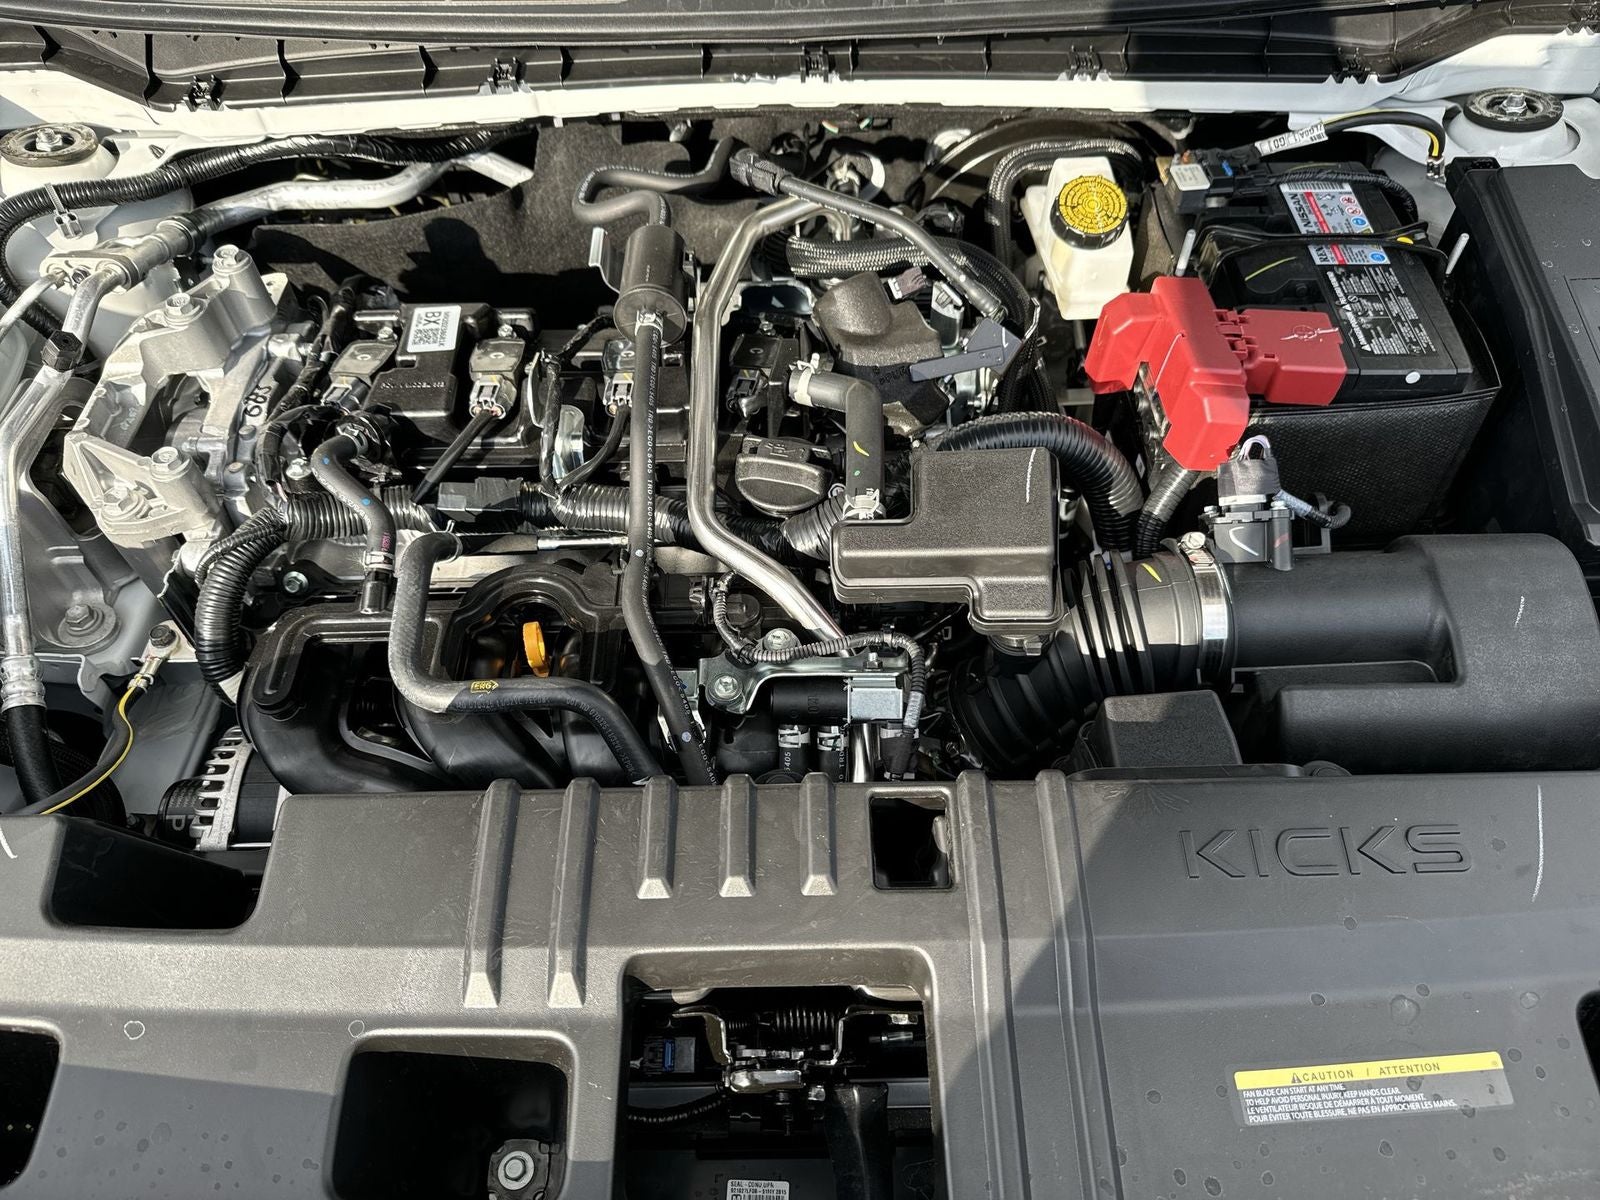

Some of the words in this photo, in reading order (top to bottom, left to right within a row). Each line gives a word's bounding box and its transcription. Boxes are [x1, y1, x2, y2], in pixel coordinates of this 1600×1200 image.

[1290, 193, 1313, 228] NISSAN
[1179, 824, 1472, 878] KICKS
[1303, 1069, 1354, 1082] CAUTION
[1379, 1062, 1440, 1076] ATTENTION
[1243, 1090, 1256, 1098] FAN
[1256, 1088, 1276, 1097] BLADE
[1276, 1088, 1289, 1096] CAN
[1290, 1086, 1308, 1094] START
[1245, 1098, 1254, 1106] TO
[1254, 1097, 1270, 1106] HELP
[1271, 1096, 1290, 1104] AVOID
[1290, 1094, 1321, 1102] PERSONAL
[1344, 1090, 1358, 1098] KEEP
[1358, 1088, 1380, 1098] HANDS
[1249, 1114, 1268, 1122] POUR
[1291, 1110, 1314, 1120] TOUTE
[1348, 1107, 1358, 1115] NE
[1358, 1106, 1370, 1114] PAS
[1370, 1105, 1380, 1114] EN
[1381, 1102, 1420, 1112] APPROCHER
[1421, 1100, 1432, 1109] LES
[1254, 1104, 1299, 1114] VENTILATEUR
[1299, 1101, 1324, 1110] RISQUE
[1376, 1095, 1394, 1104] TOUT
